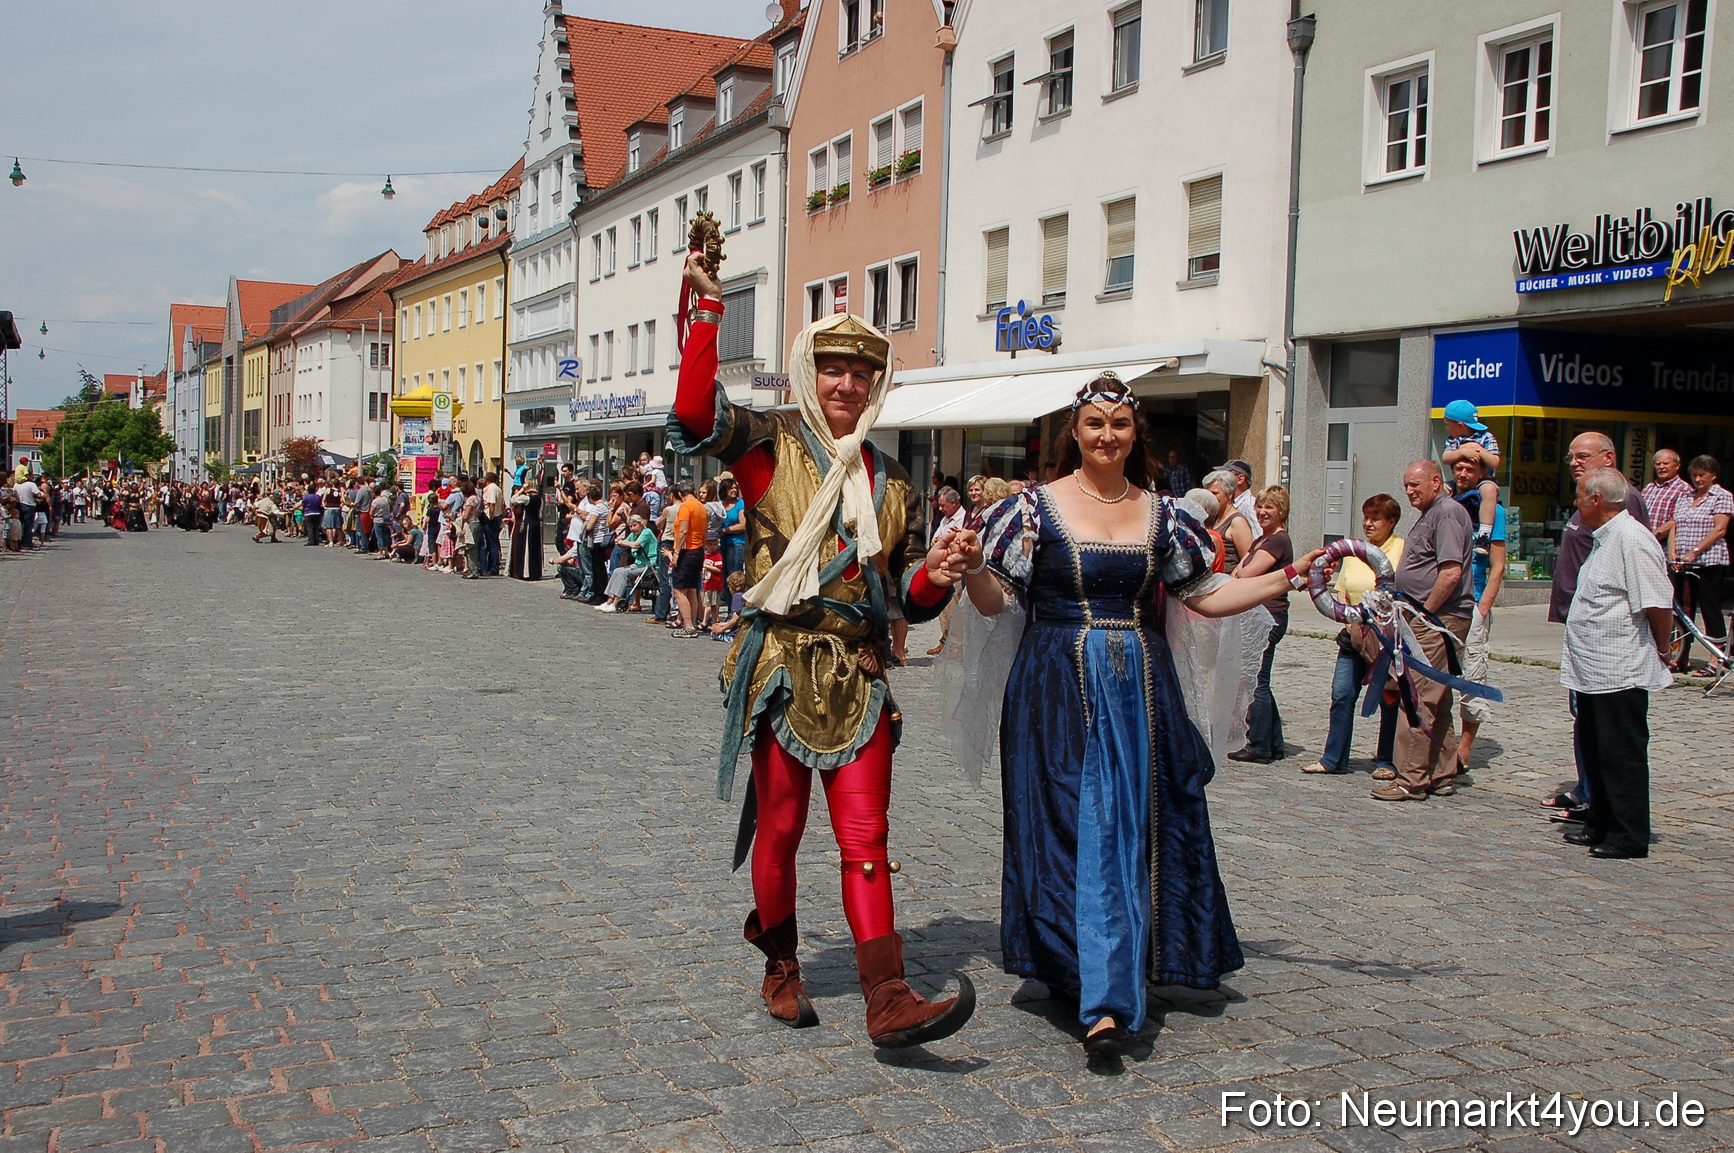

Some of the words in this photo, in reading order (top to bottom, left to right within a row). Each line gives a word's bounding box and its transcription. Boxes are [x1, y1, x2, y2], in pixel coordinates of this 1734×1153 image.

[1519, 278, 1558, 292] BÜCHER
[1568, 272, 1602, 286] MUSIK
[1613, 266, 1653, 281] VIDEOS
[1447, 358, 1503, 381] Bücher
[1539, 353, 1623, 387] Videos
